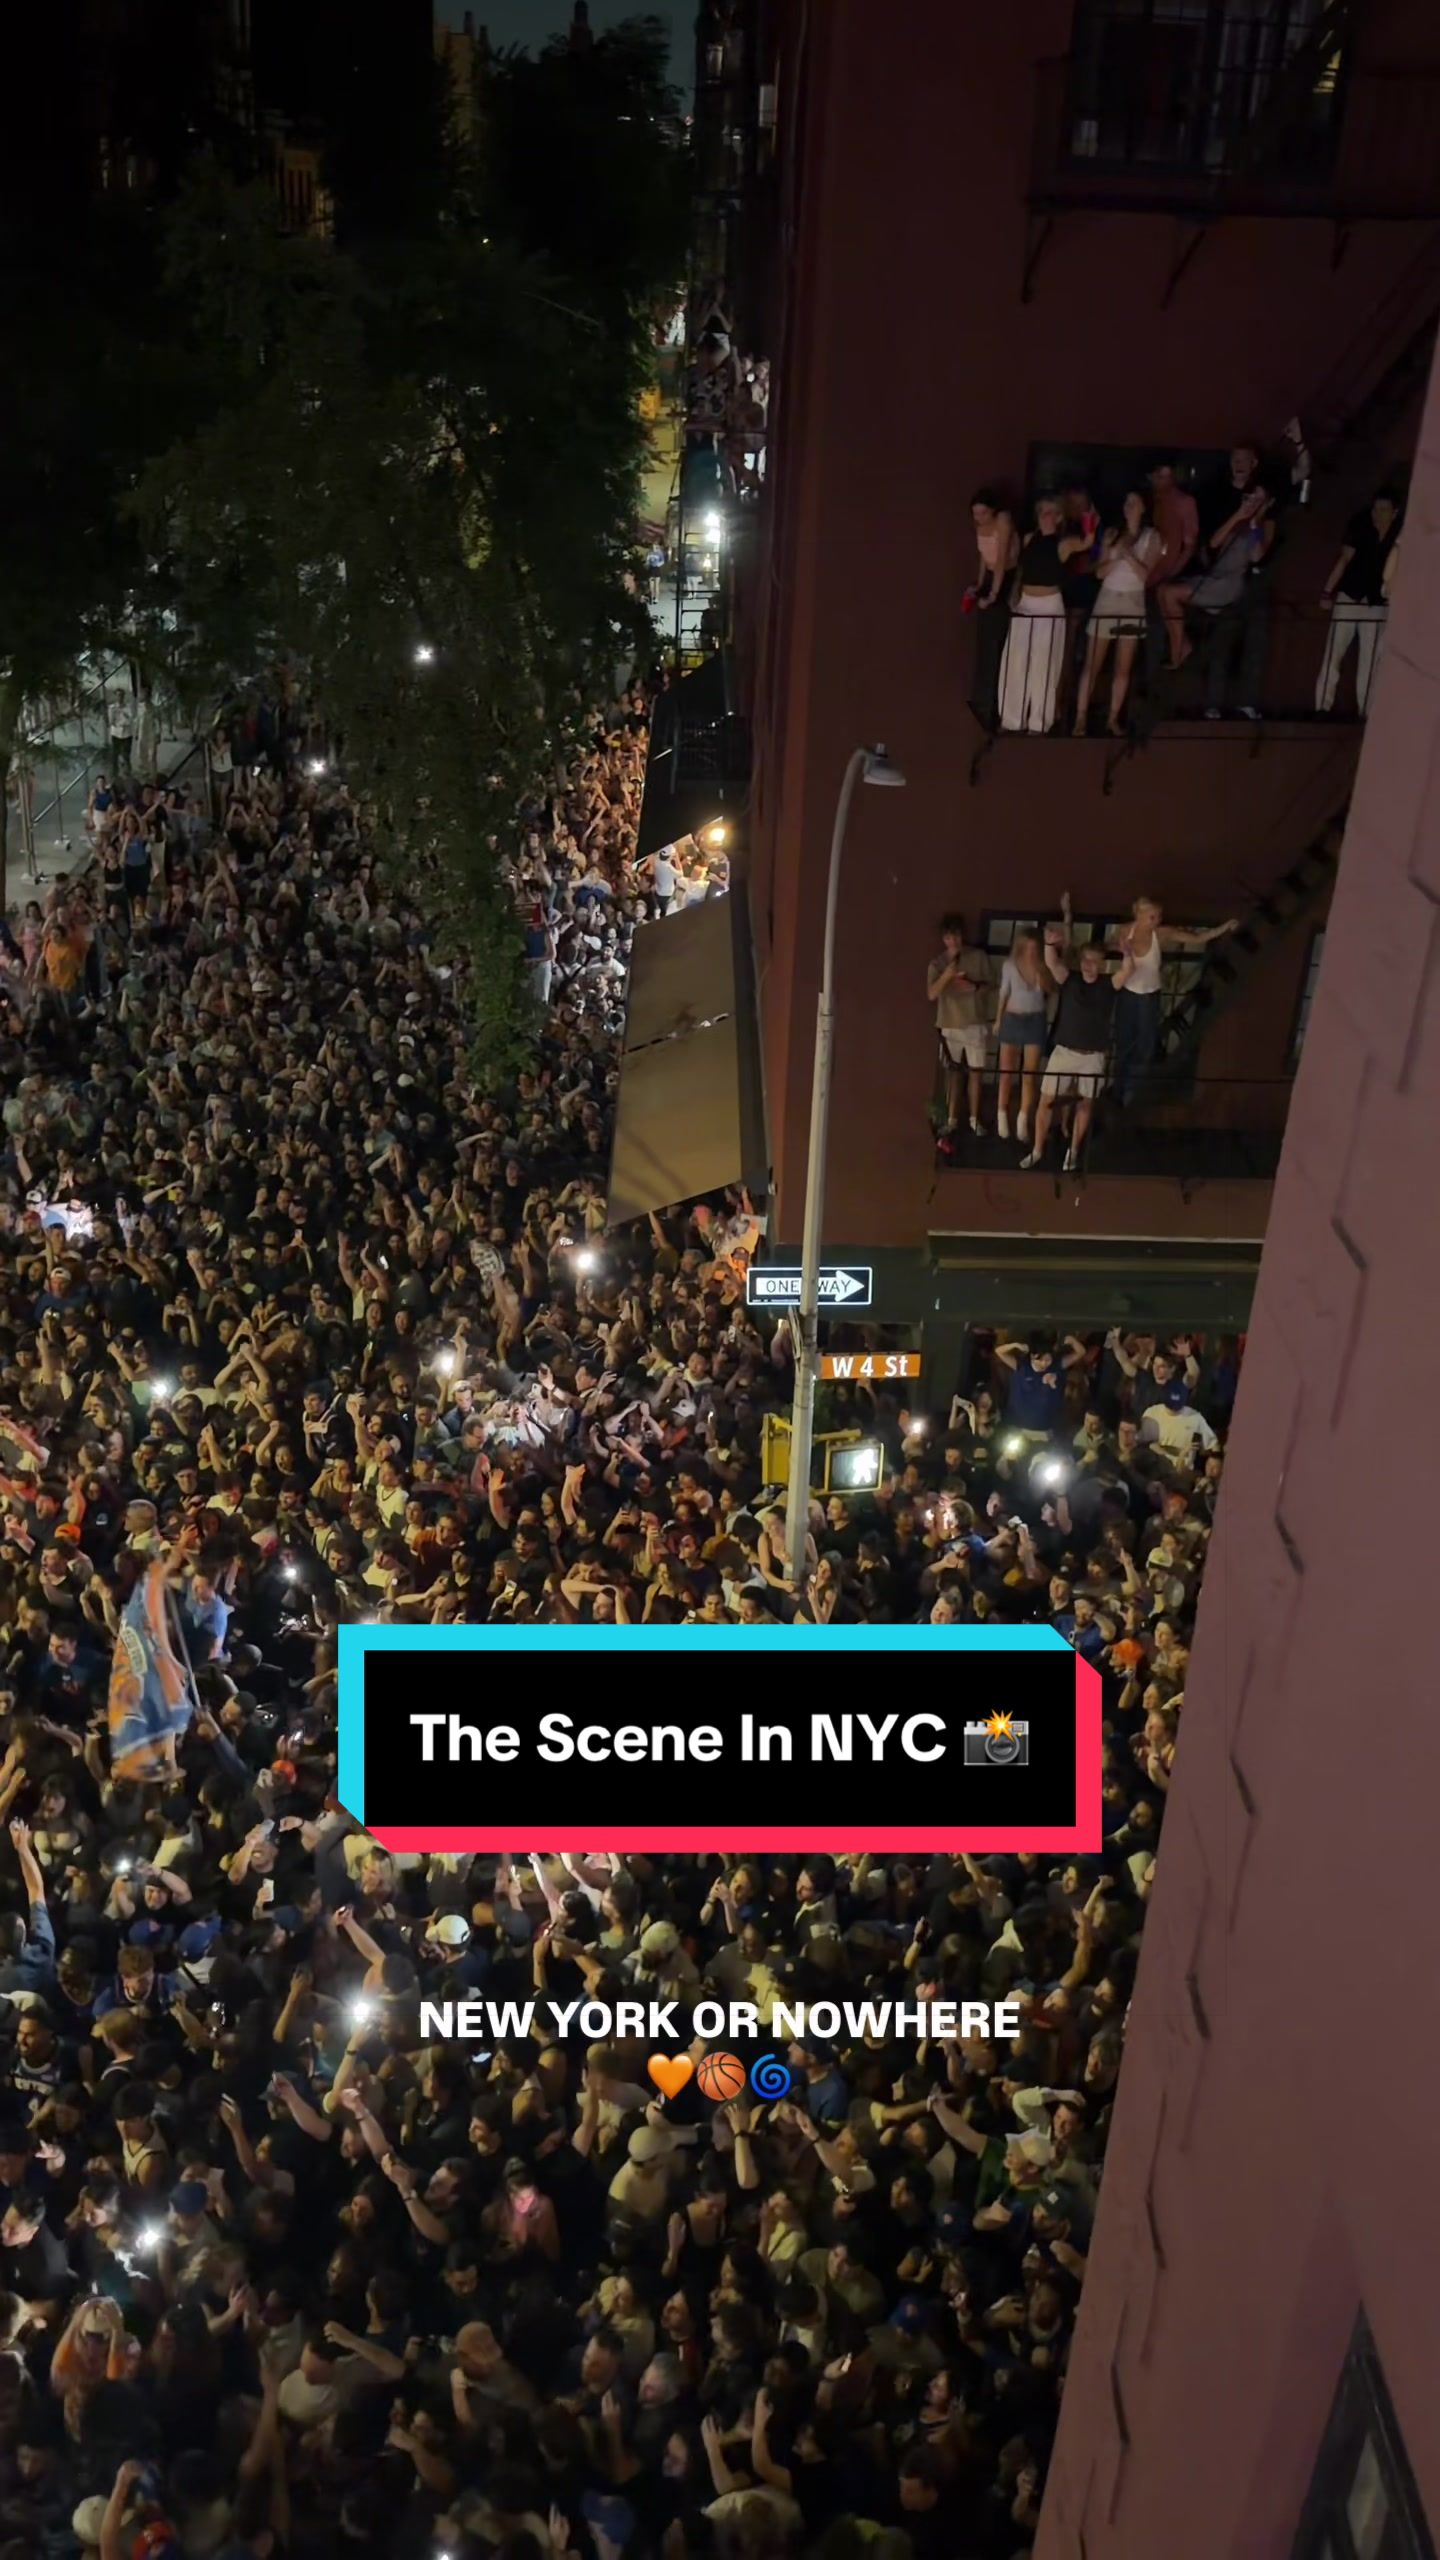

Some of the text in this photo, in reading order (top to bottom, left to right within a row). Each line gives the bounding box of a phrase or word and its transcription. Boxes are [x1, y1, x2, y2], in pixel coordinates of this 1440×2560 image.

[766, 1279, 852, 1293] ONE WAY
[832, 1354, 908, 1378] W 4 St
